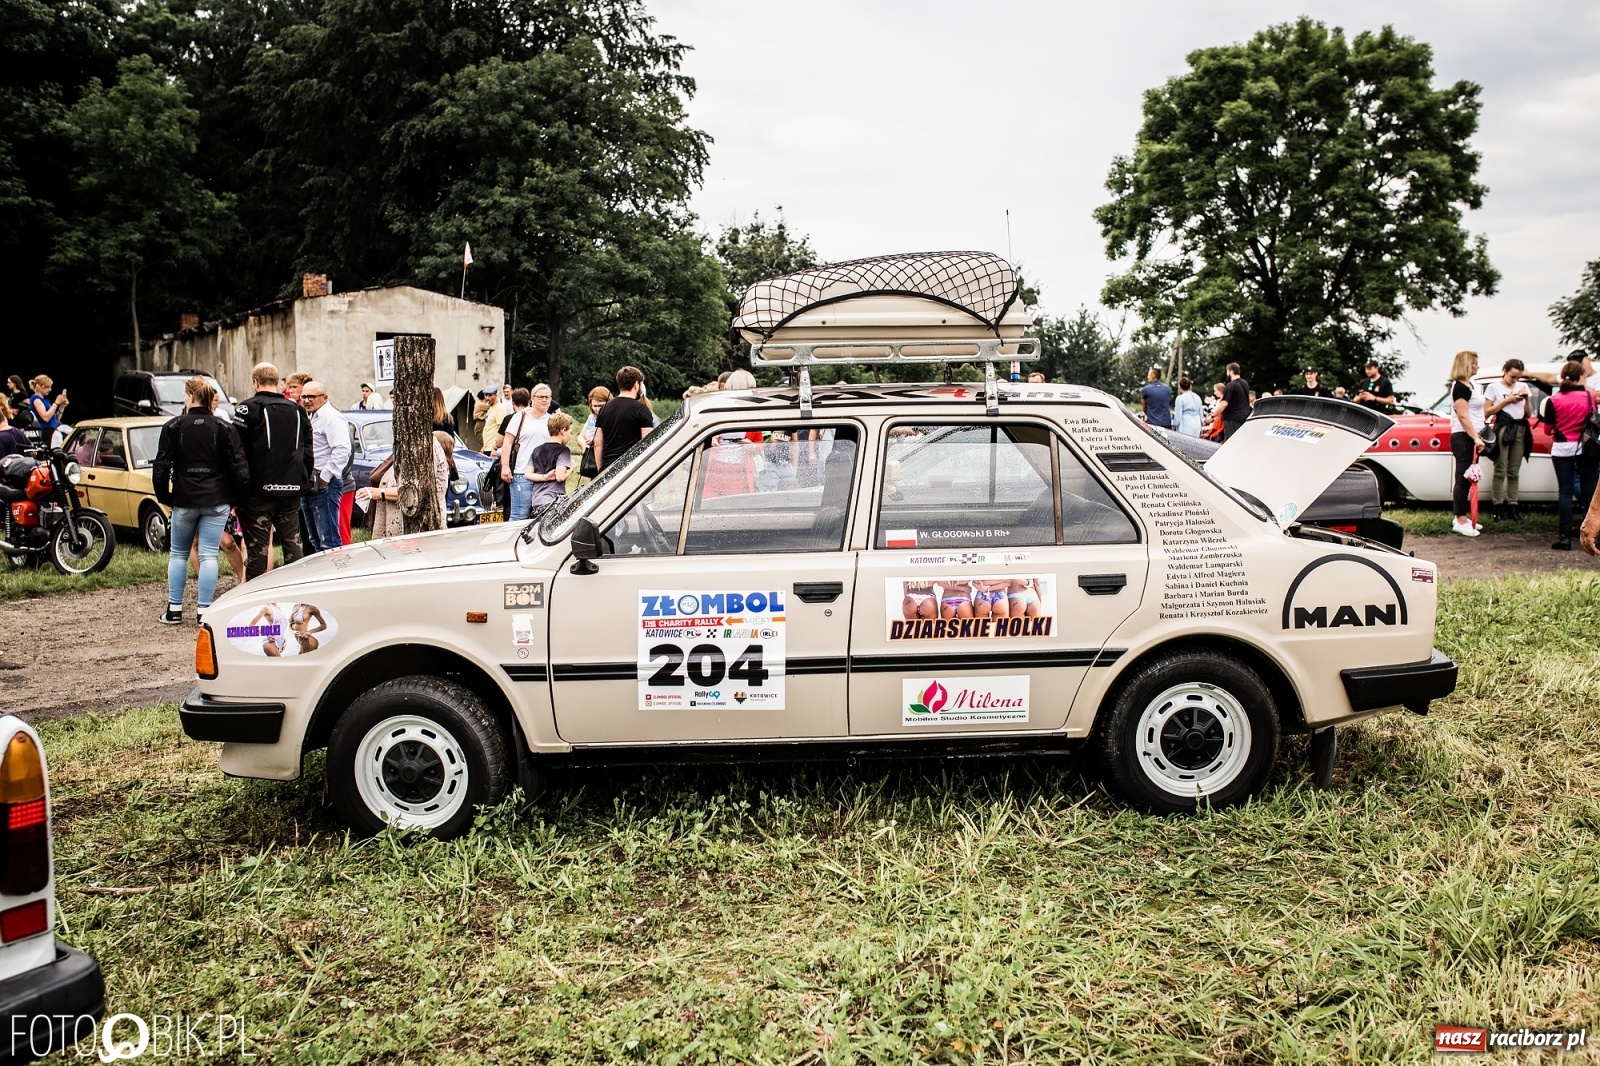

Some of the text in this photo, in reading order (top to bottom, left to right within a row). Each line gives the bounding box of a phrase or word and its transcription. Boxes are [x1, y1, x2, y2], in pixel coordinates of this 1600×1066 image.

[932, 530, 984, 538] GŁOGOWSKI
[1205, 560, 1243, 569] Lamparski
[1167, 573, 1187, 581] Edyta
[506, 593, 541, 605] BOL
[642, 592, 784, 616] ZŁOMBOL
[1190, 610, 1223, 618] Krzysztof
[1294, 604, 1396, 629] MAN
[659, 618, 693, 627] CHARITY
[695, 617, 718, 626] RALLY
[646, 629, 683, 638] KATOWICE
[890, 617, 1052, 639] DZIARSKIE HOLKI
[648, 644, 768, 687] 204
[940, 689, 1023, 712] Milena
